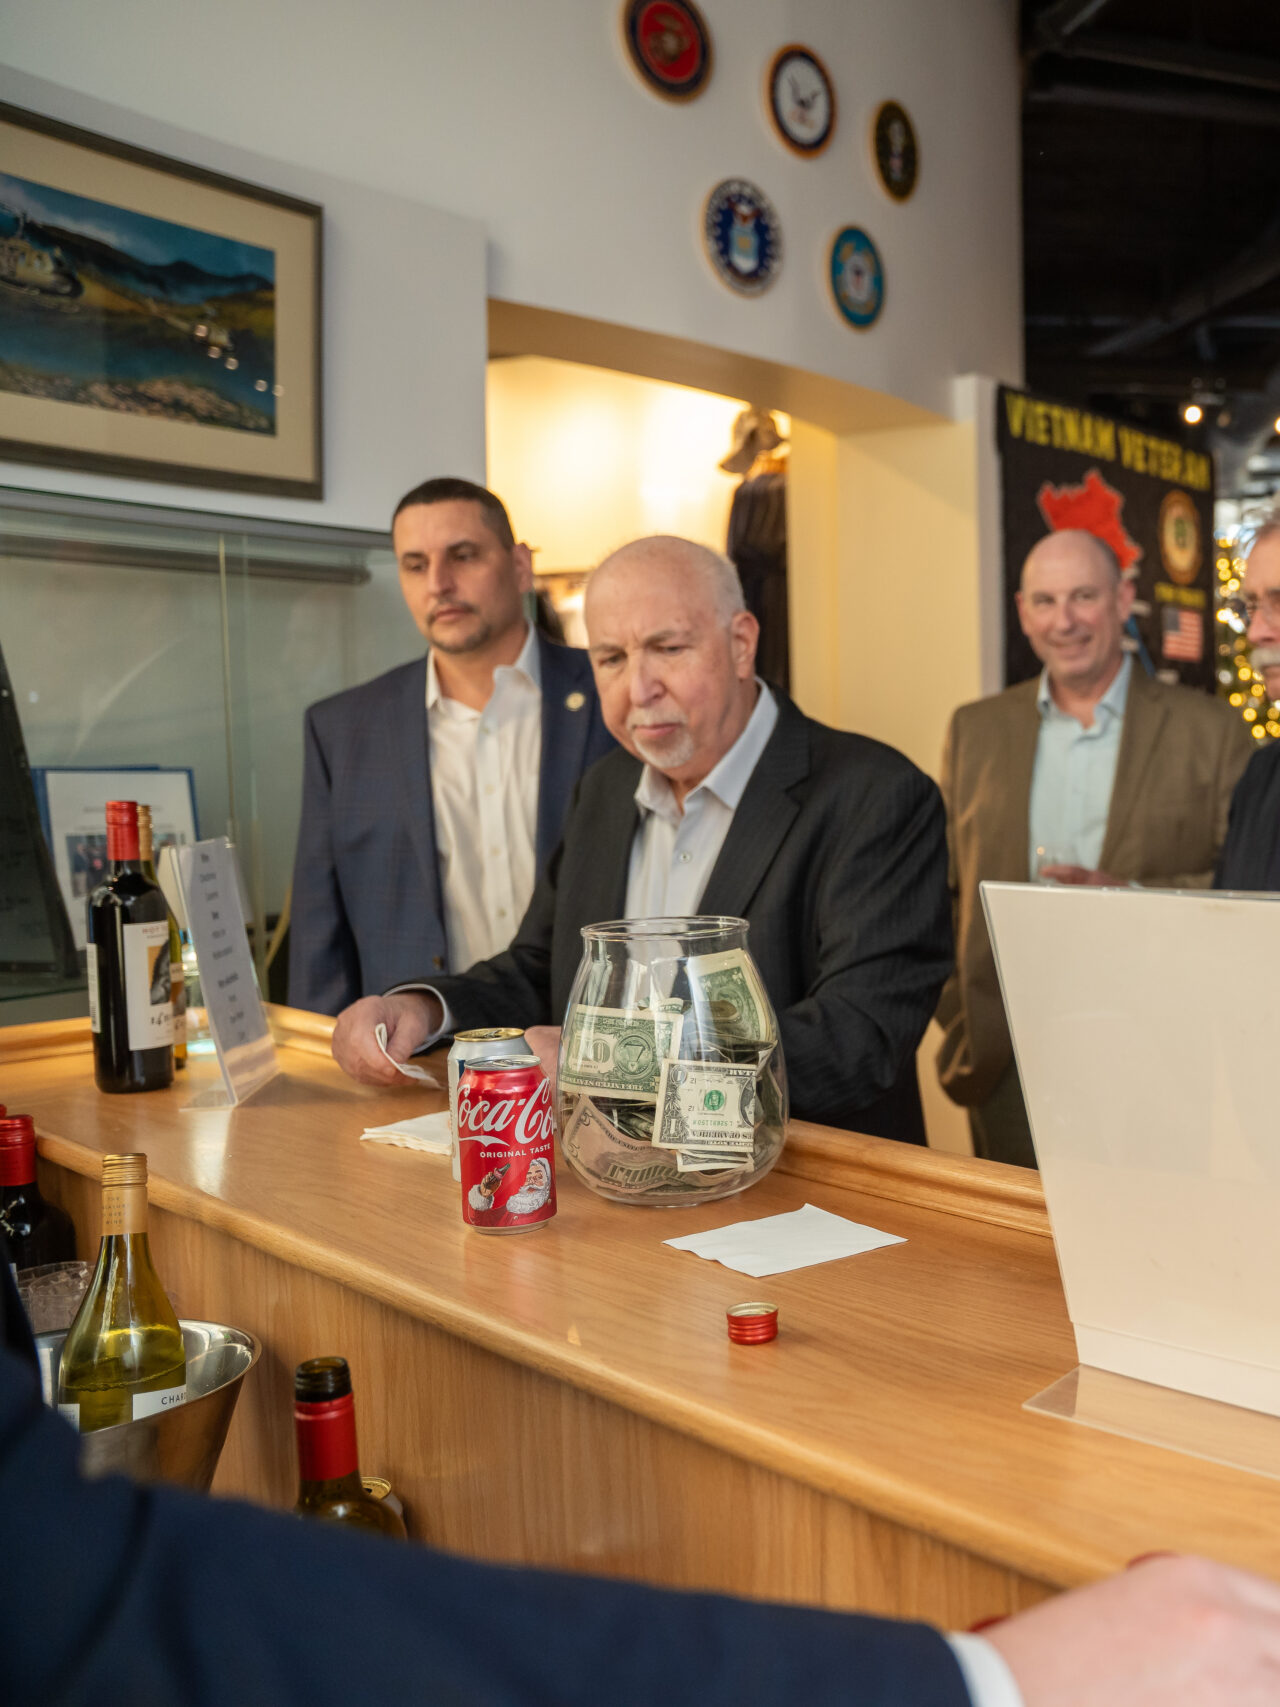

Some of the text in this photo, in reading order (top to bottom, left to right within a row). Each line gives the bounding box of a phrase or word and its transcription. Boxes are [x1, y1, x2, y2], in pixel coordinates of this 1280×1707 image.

[1005, 391, 1211, 492] VIETNAM VETERAN
[692, 1130, 730, 1139] AMERICA
[480, 1143, 552, 1159] ORIGINAL TASTE
